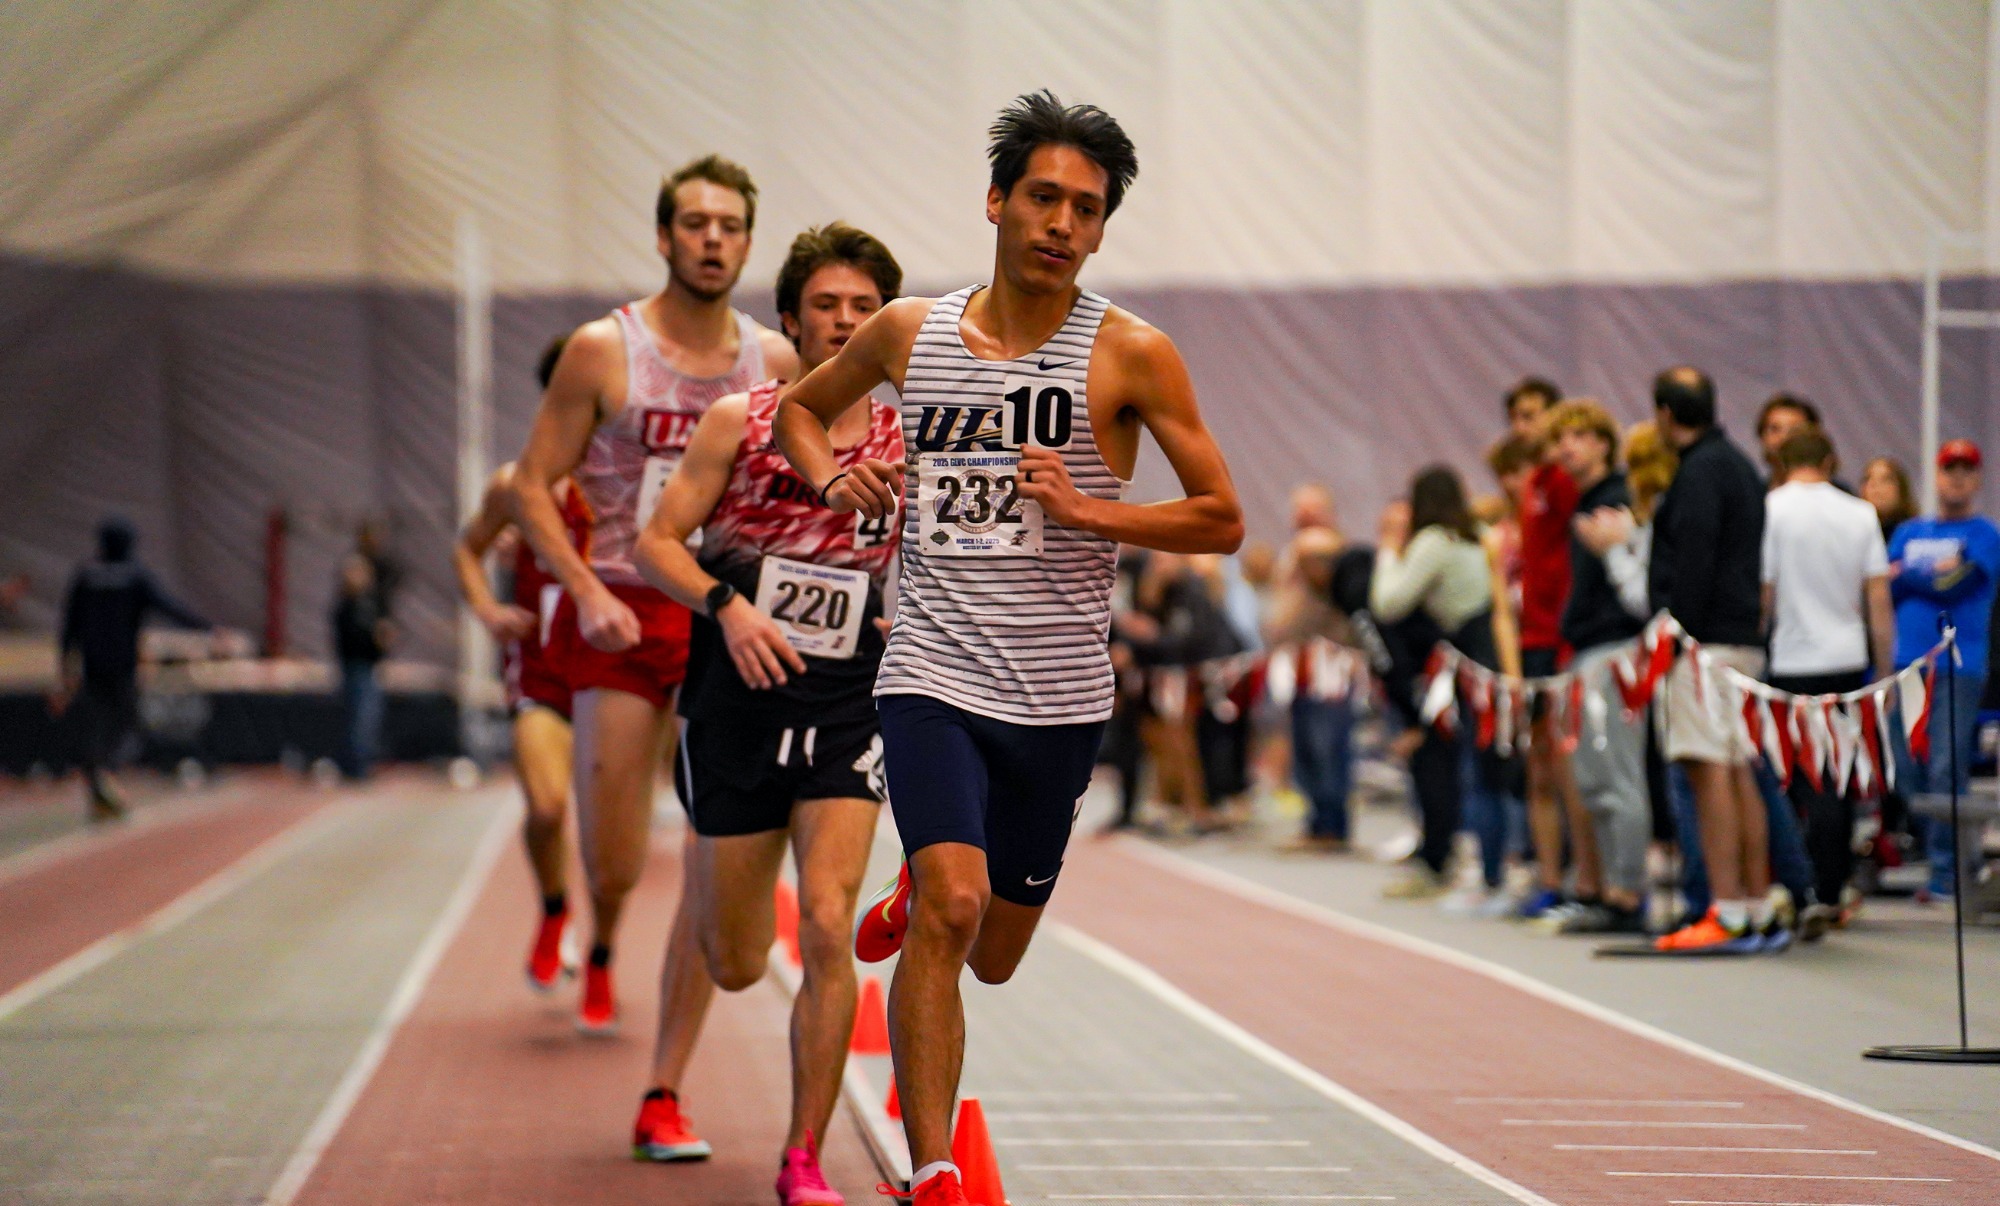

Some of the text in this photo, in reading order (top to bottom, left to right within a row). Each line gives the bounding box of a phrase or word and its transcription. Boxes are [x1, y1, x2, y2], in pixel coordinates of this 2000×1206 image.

[1005, 386, 1073, 447] 10
[932, 458, 949, 467] 2025
[950, 458, 966, 467] GLVC
[937, 475, 1023, 523] 232
[771, 581, 850, 629] 220
